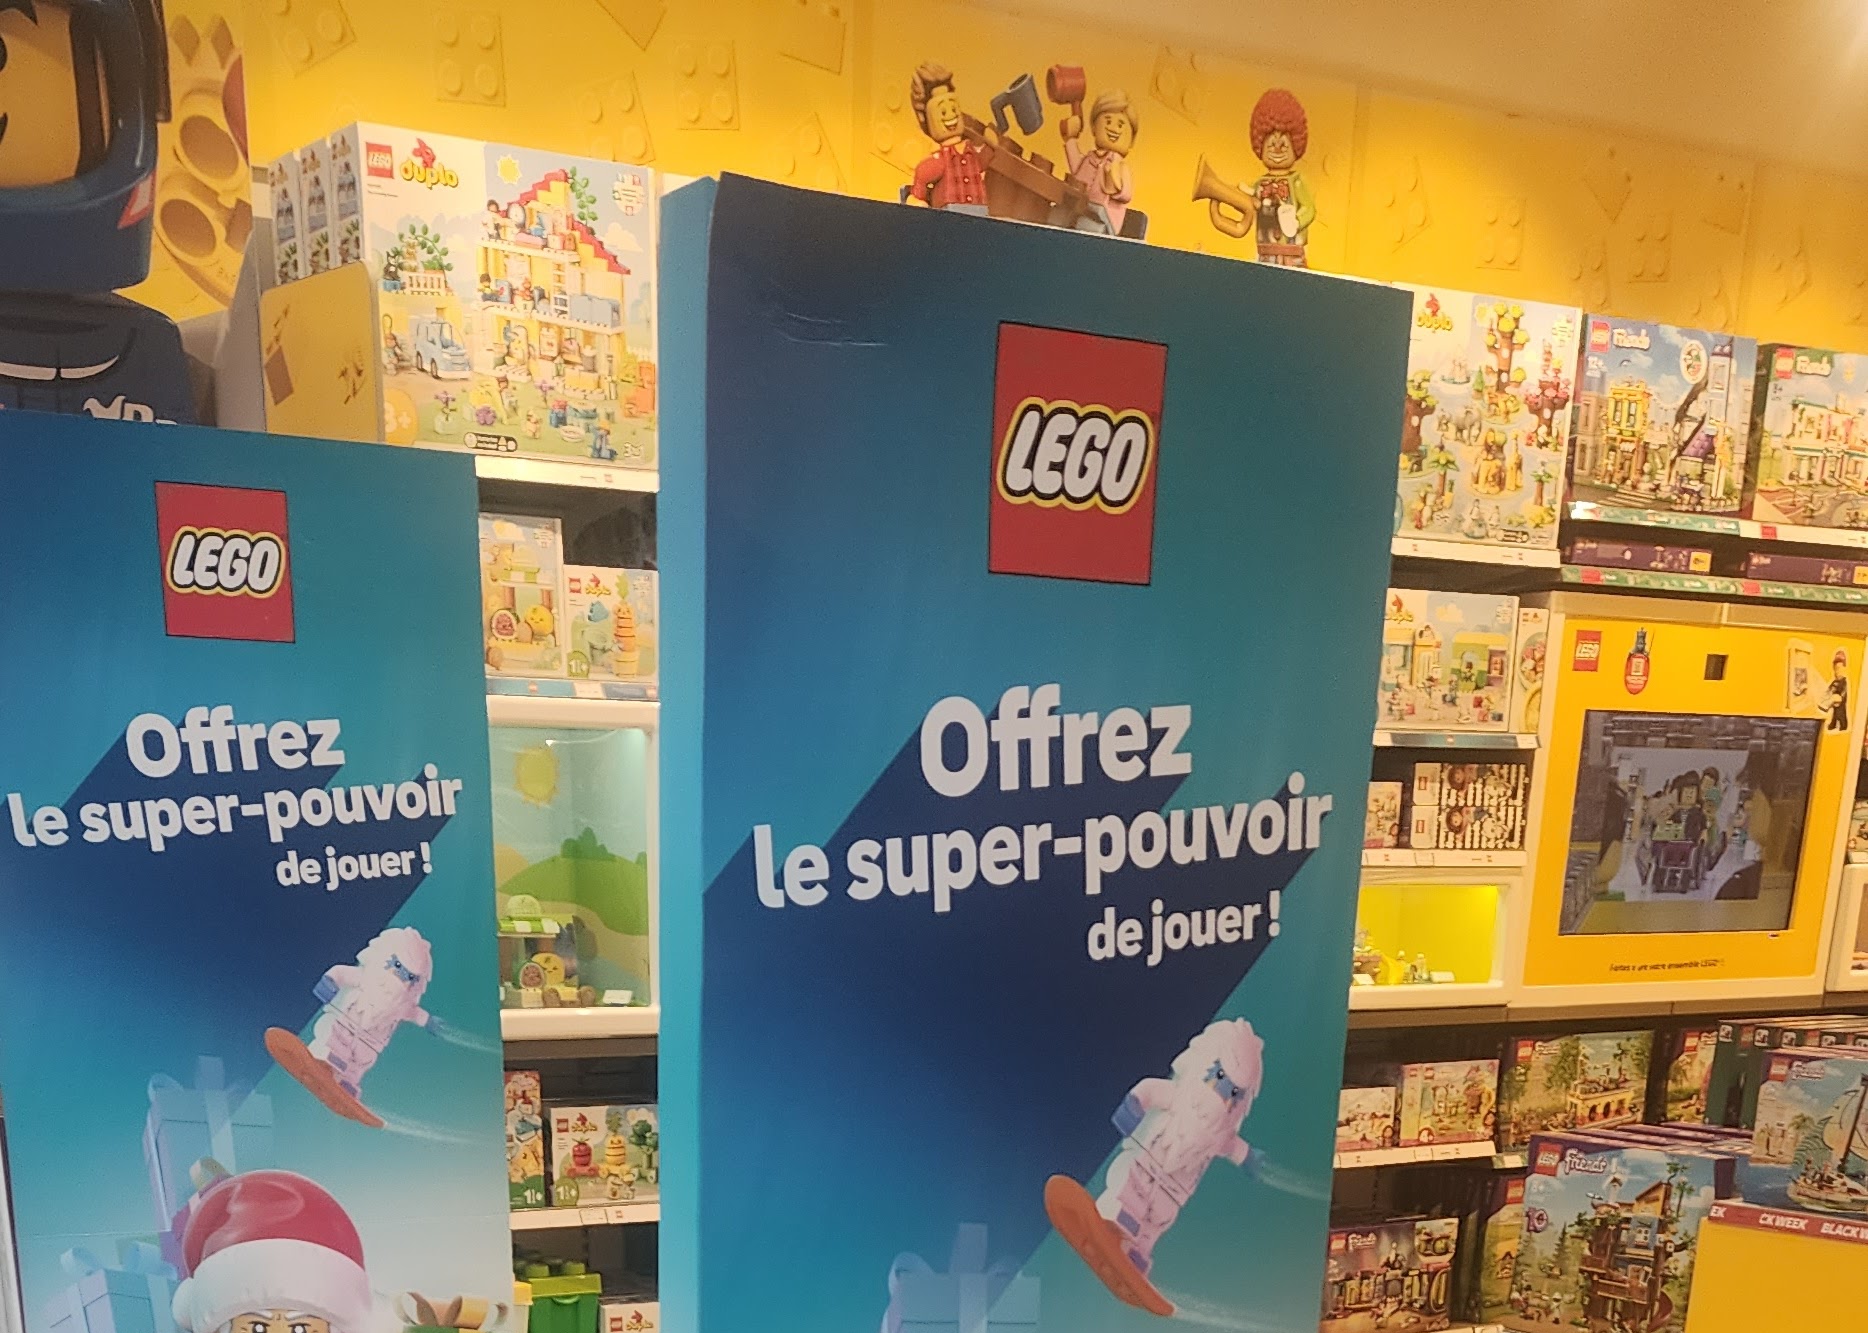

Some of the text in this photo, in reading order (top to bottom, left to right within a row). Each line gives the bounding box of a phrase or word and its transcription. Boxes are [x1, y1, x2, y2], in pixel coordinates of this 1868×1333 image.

[400, 159, 458, 190] duplo
[1001, 402, 1152, 507] LEGO
[168, 528, 284, 595] LEGO
[1576, 643, 1599, 659] LEGO
[126, 705, 345, 777] Offrez
[921, 684, 1192, 797] Offrez
[8, 763, 462, 851] le super-pouvoir
[277, 850, 321, 886] de
[754, 772, 1332, 912] le super-pouvoir
[1088, 907, 1143, 960] de
[1775, 1215, 1809, 1230] WEEK
[1820, 1222, 1859, 1239] BLACK
